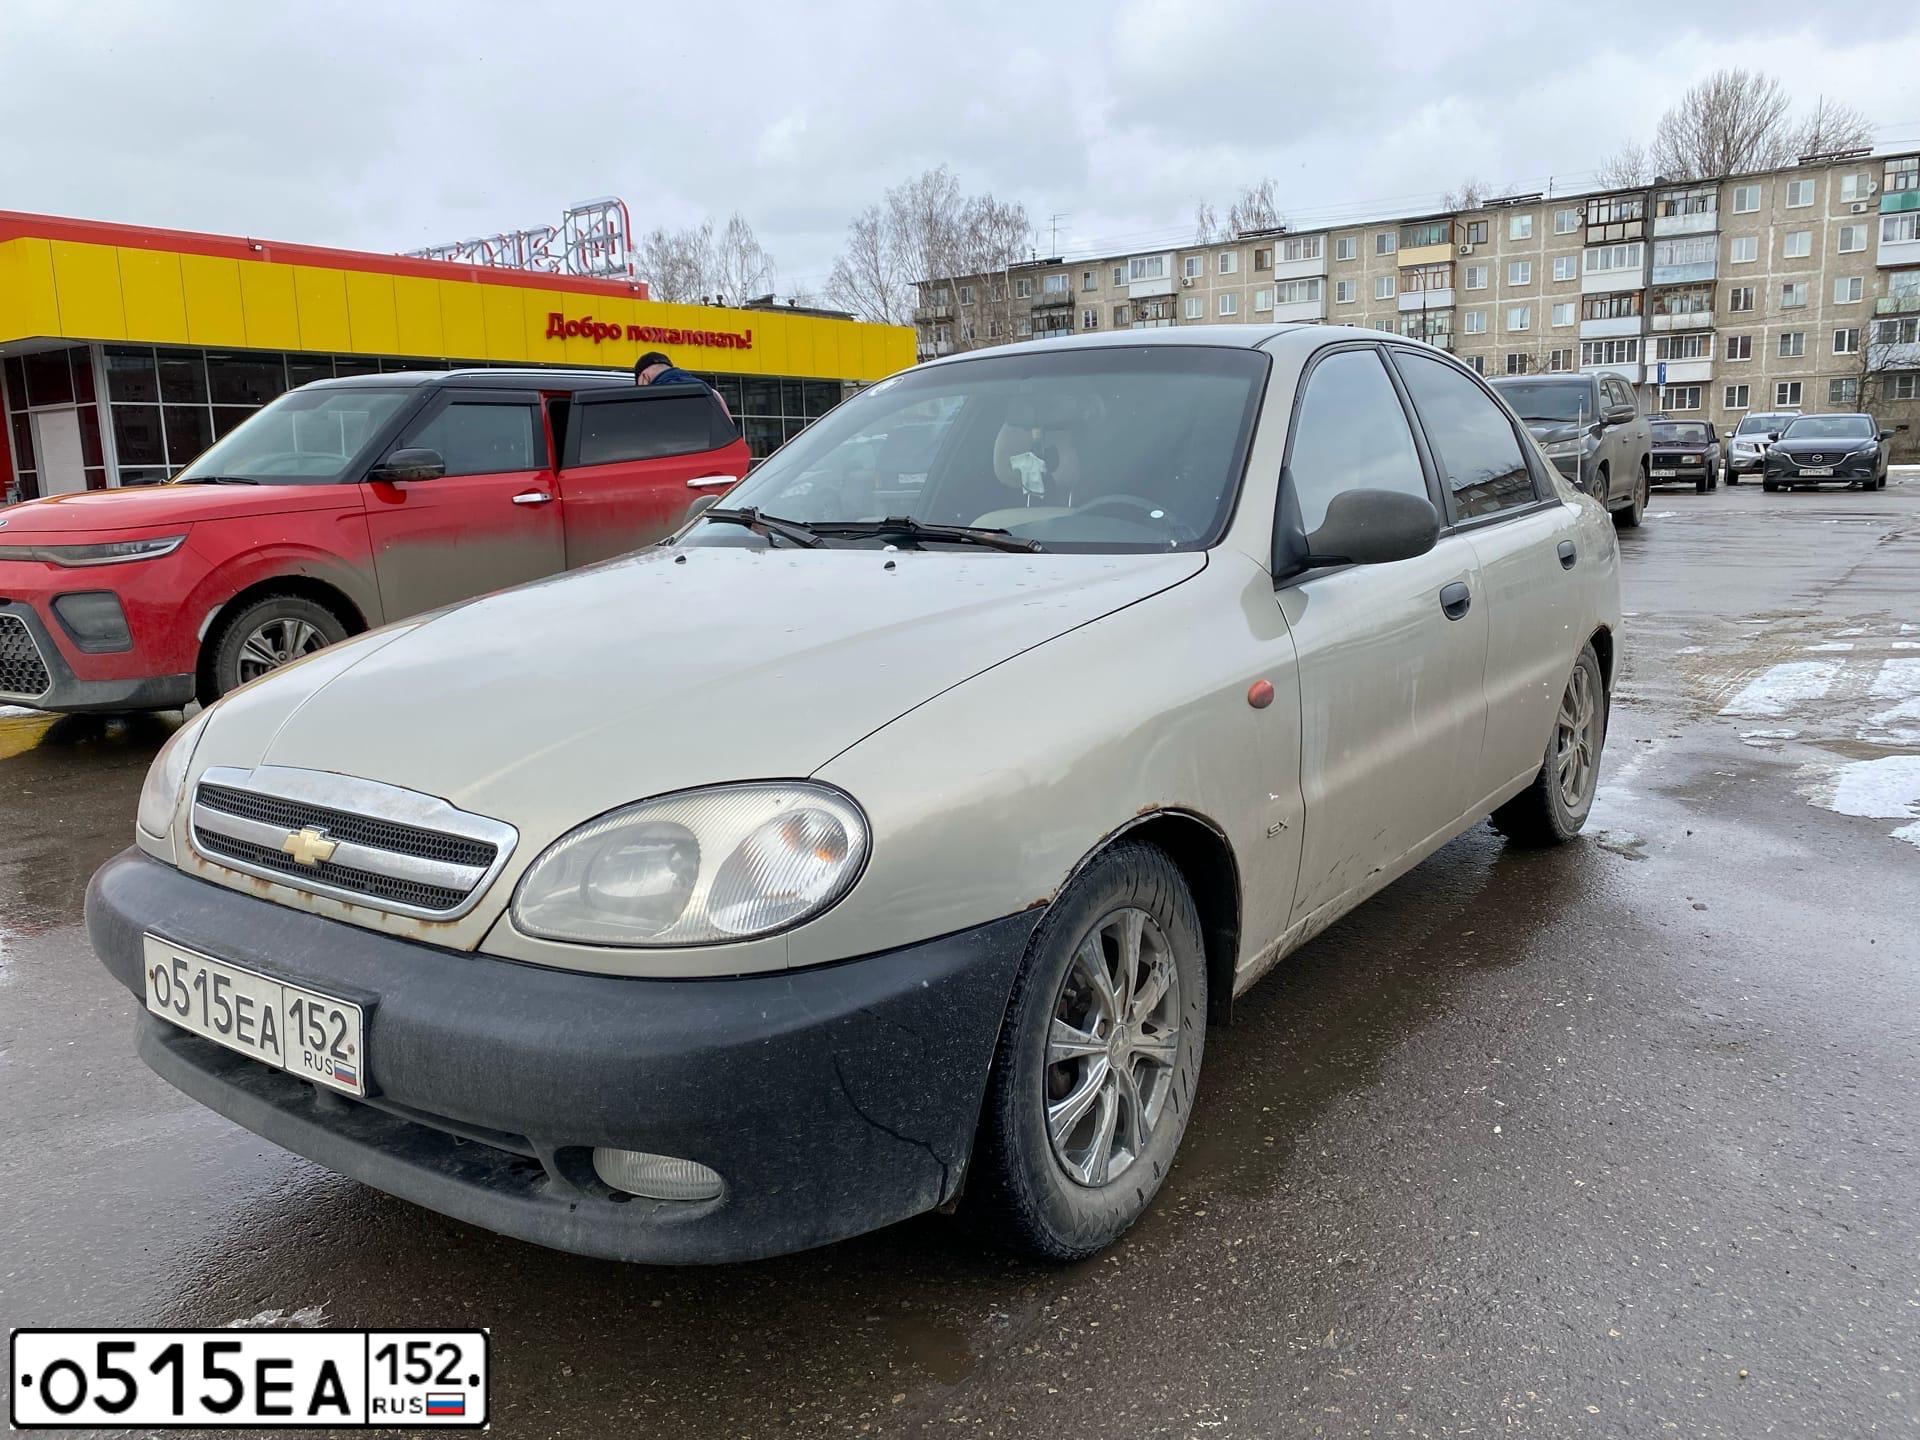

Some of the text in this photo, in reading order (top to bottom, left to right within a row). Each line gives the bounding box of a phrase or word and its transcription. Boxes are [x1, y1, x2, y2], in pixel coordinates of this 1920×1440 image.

[547, 312, 752, 349] Добро пожаловать!
[289, 997, 348, 1060] 152
[304, 1050, 333, 1076] RUS
